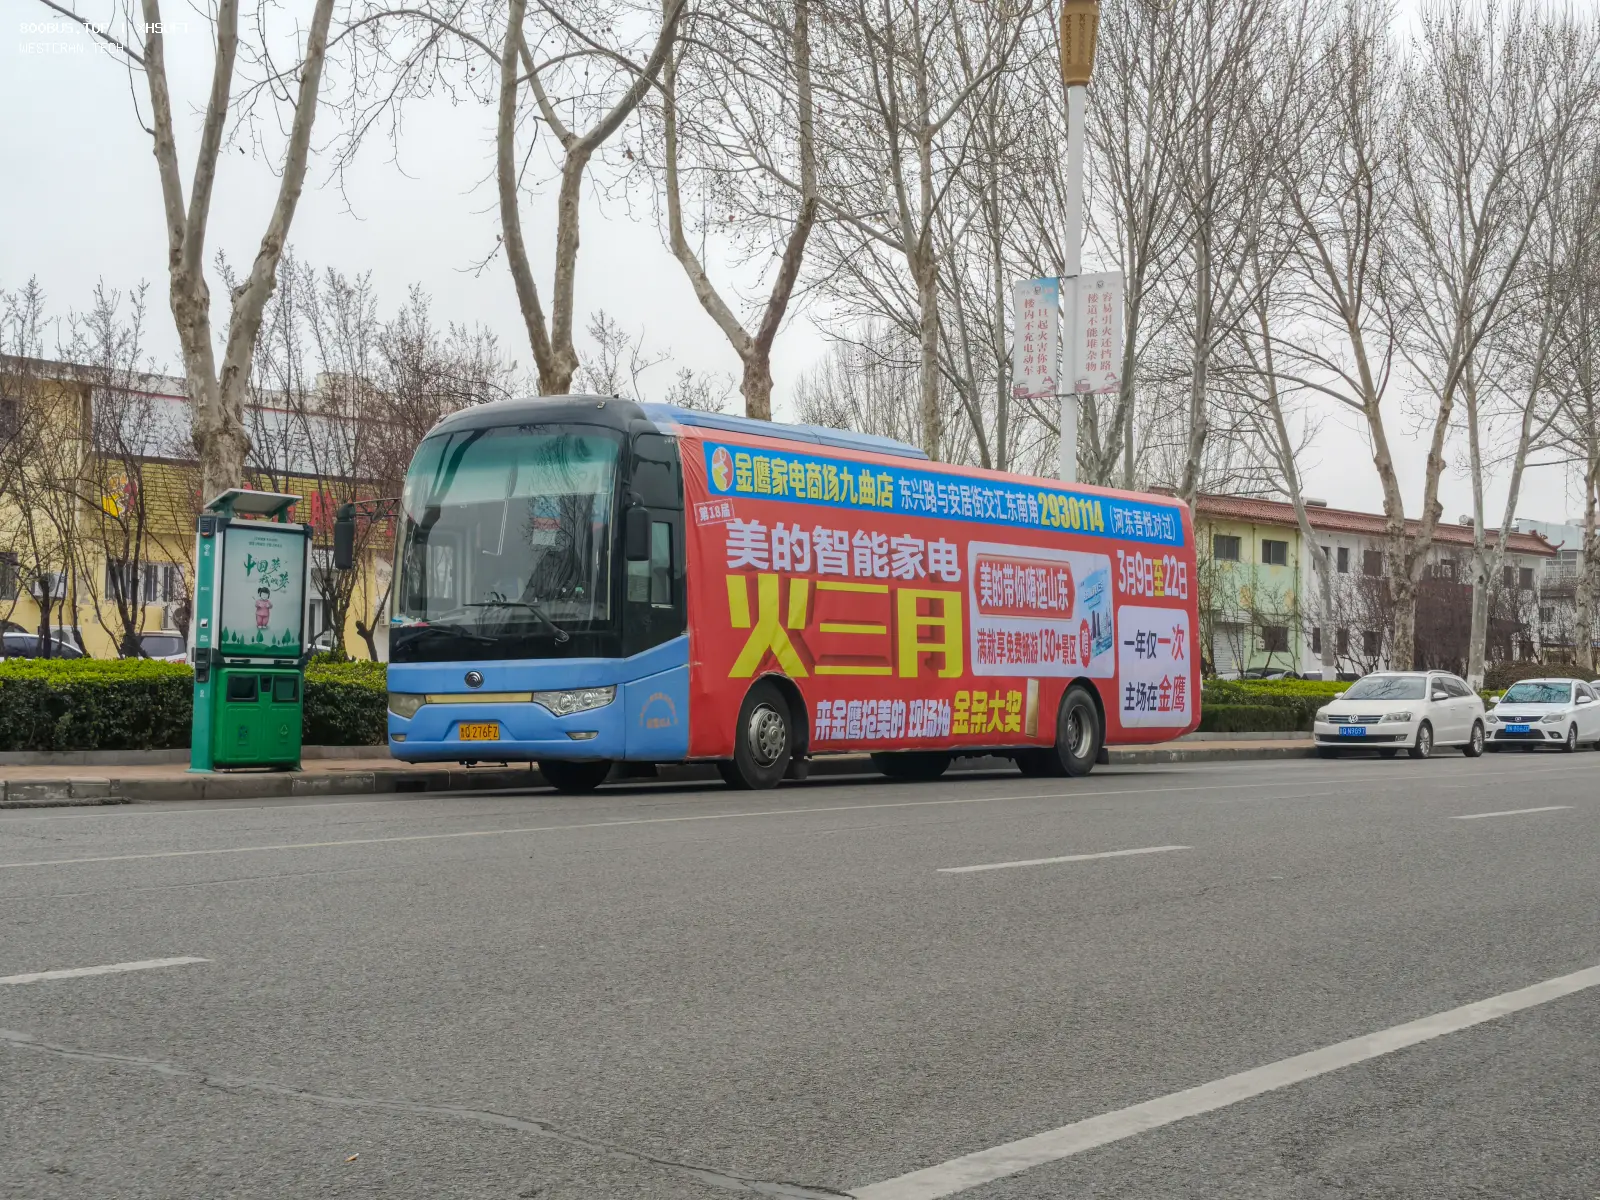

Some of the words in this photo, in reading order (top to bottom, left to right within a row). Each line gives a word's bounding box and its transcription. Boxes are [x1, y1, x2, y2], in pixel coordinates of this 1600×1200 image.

[699, 503, 732, 523] 第18届
[735, 452, 894, 508] 金鹰家电商场九曲店
[1038, 492, 1105, 533] 2930114
[725, 517, 962, 583] 美的智能家电
[1117, 549, 1188, 600] 3月9日至22日
[979, 561, 1069, 611] 美的带你嗨逛山东
[725, 573, 964, 678] 火三月
[1123, 624, 1186, 661] 一年仅一次
[1123, 674, 1187, 712] 主场在金鹰
[815, 699, 906, 741] 来金鹰抢美的
